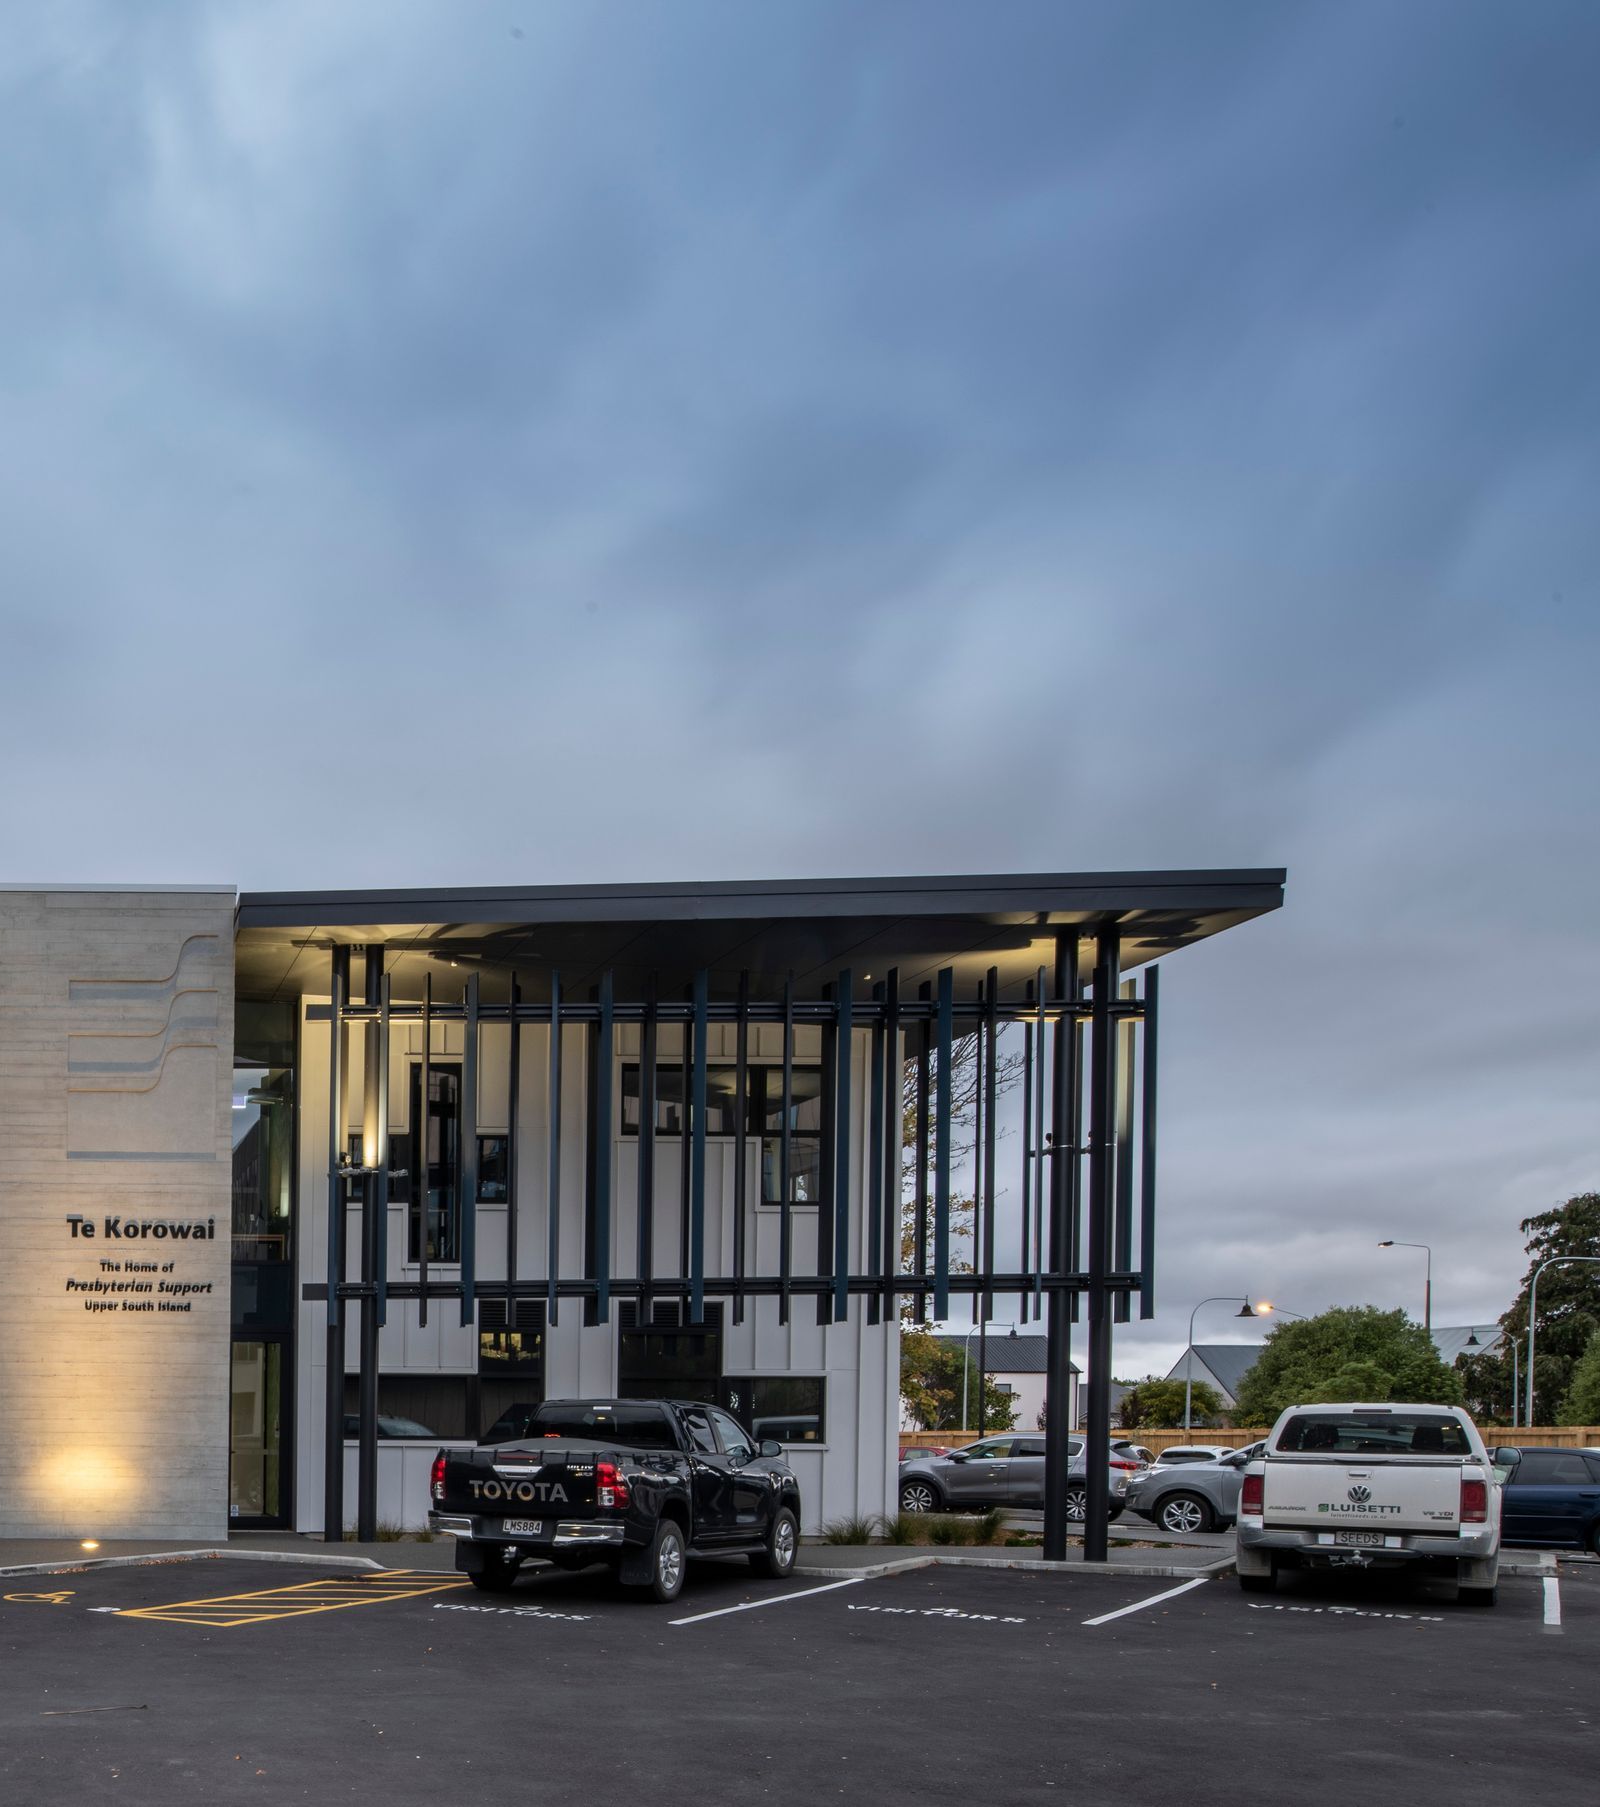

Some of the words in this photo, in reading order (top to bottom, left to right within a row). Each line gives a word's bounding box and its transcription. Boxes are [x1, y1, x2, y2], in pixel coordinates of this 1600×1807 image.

[66, 1215, 95, 1238] Te
[105, 1217, 215, 1239] Korowai
[100, 1261, 121, 1272] The
[125, 1261, 158, 1272] Home
[162, 1261, 174, 1272] of
[66, 1279, 153, 1295] Presbyterian
[157, 1281, 212, 1296] Support
[85, 1301, 118, 1313] Upper
[122, 1301, 154, 1312] South
[158, 1302, 191, 1312] Island
[469, 1480, 568, 1502] TOYOTA
[1331, 1504, 1401, 1514] LUISETTI
[504, 1520, 541, 1533] LMS884
[1341, 1532, 1379, 1544] SEEDS
[433, 1603, 591, 1620] VISITORS
[847, 1604, 1027, 1623] VISITORS
[1247, 1603, 1445, 1622] VISITORS
